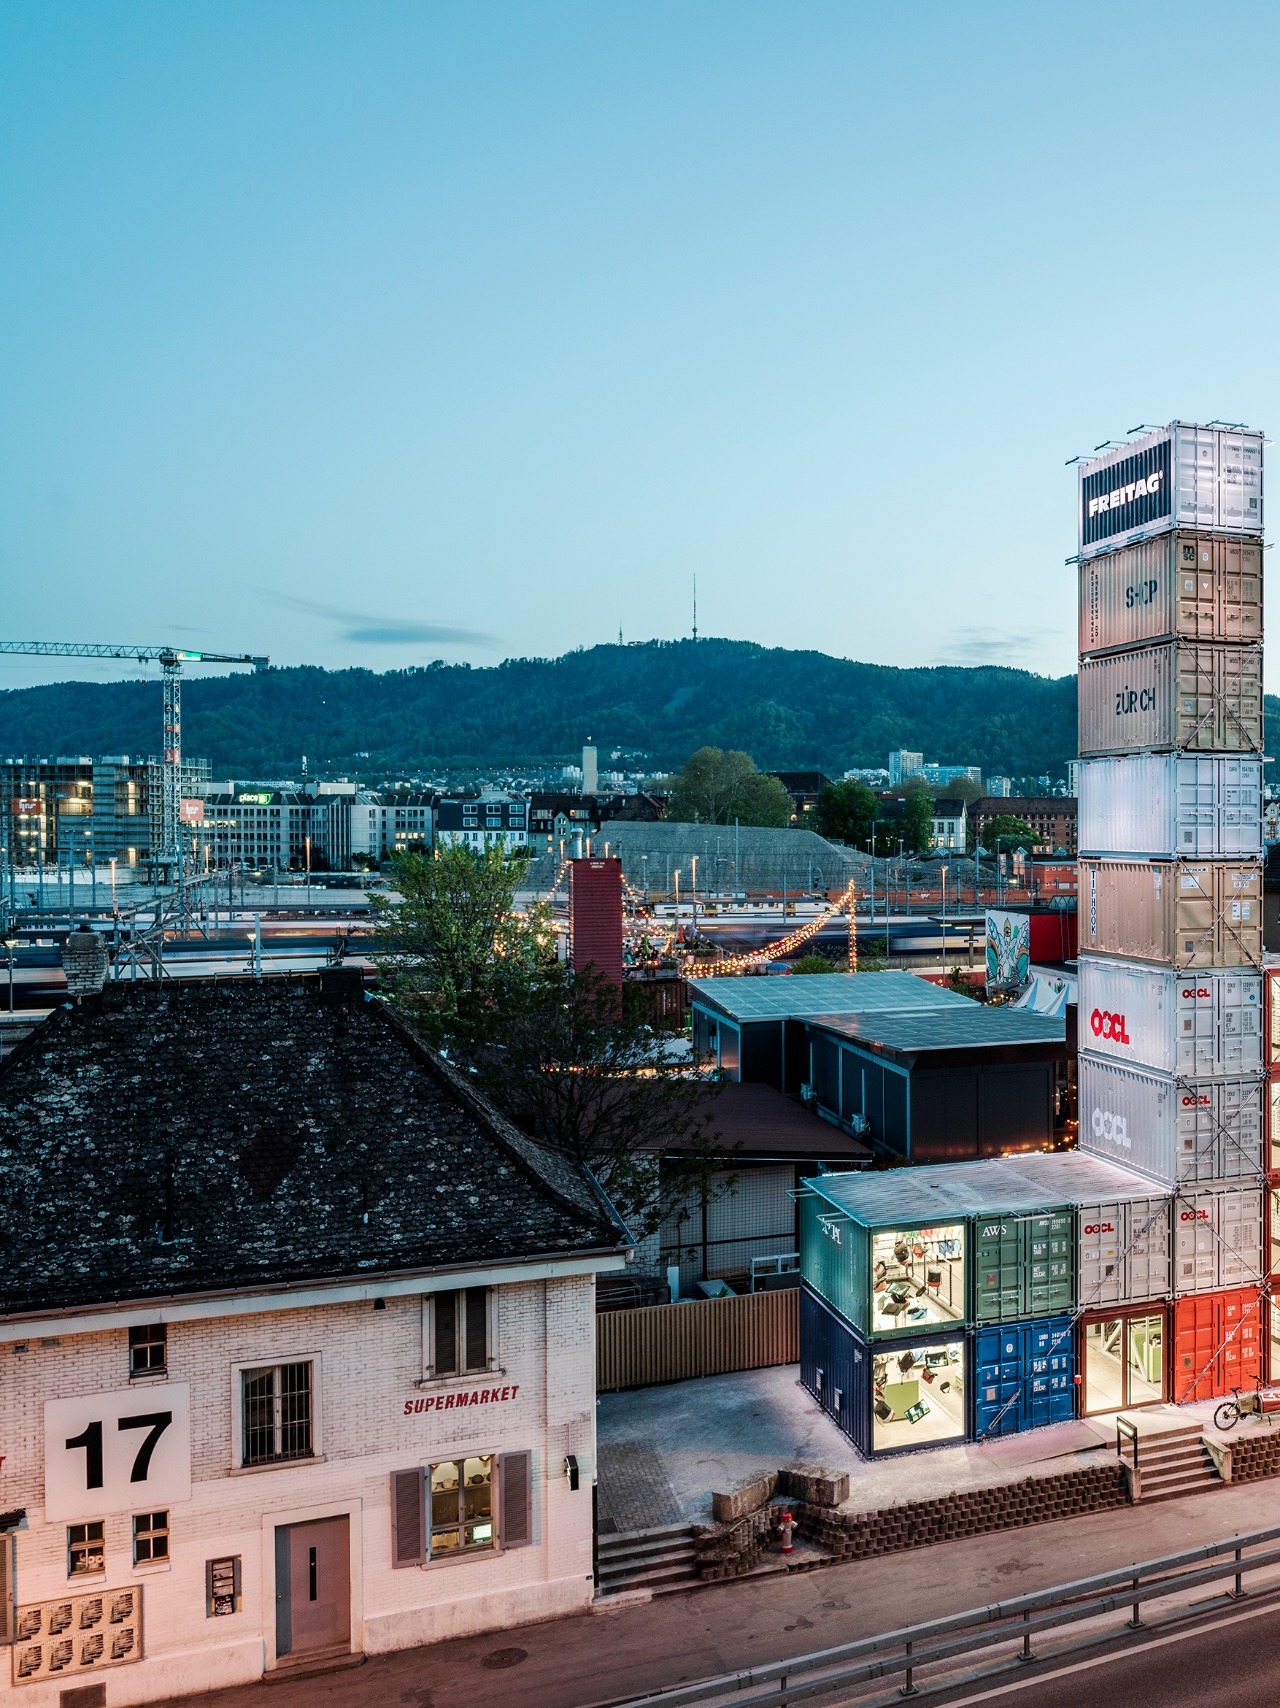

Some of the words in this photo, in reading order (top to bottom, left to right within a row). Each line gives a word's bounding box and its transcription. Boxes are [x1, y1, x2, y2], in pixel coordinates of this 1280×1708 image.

[1116, 685, 1156, 716] ZÜRCH
[982, 1225, 1008, 1237] AWS
[403, 1385, 520, 1415] SUPERMARKET
[65, 1411, 173, 1490] 17
